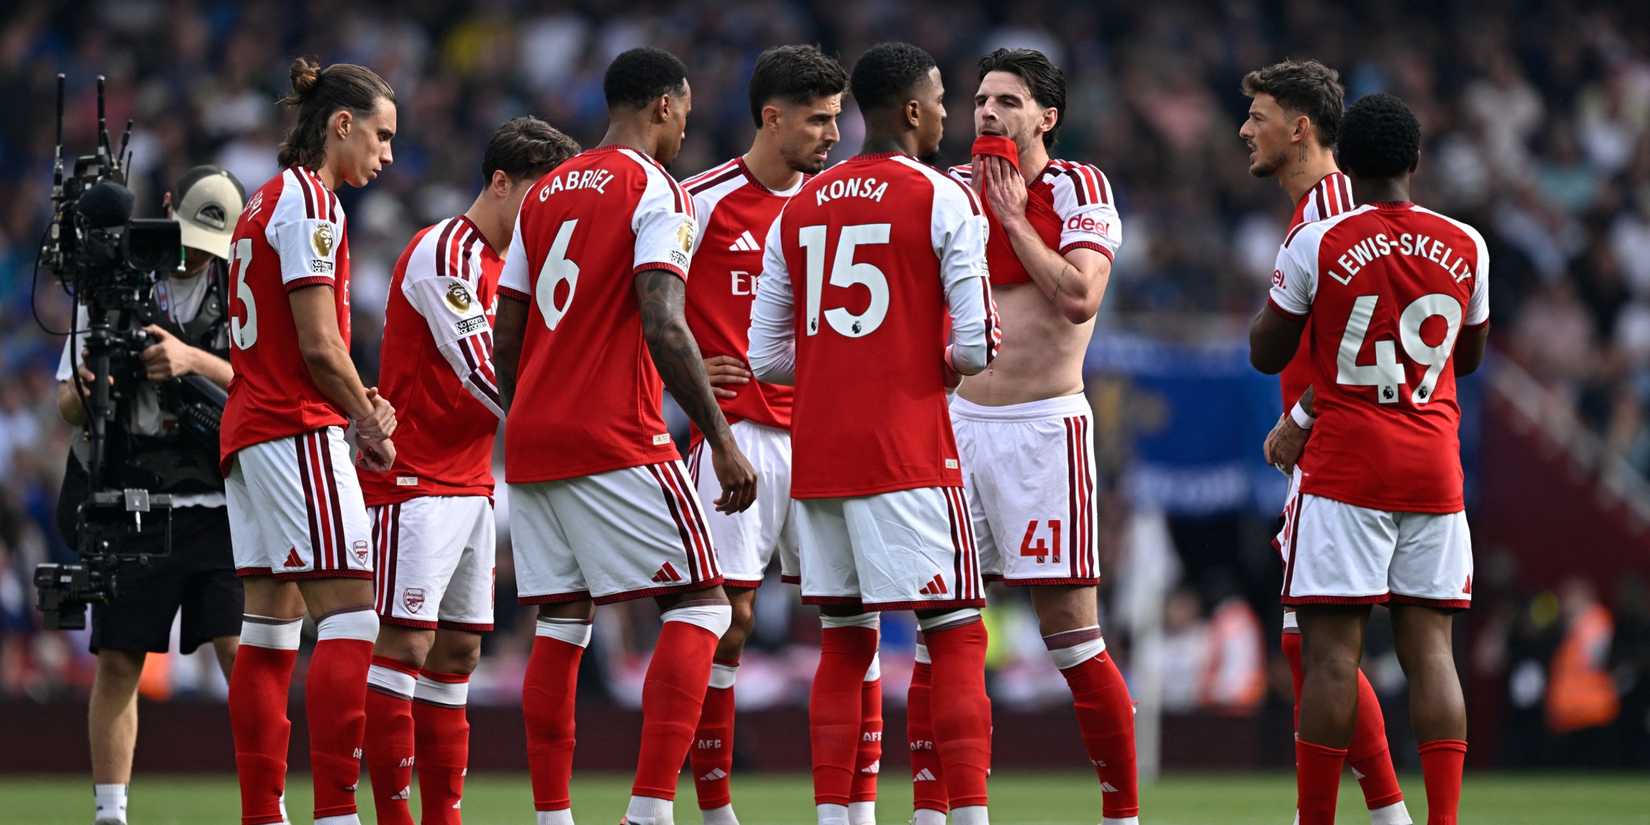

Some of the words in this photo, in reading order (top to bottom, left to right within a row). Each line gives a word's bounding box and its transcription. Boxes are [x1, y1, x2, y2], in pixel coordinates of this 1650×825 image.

[539, 168, 615, 203] GABRIEL
[815, 177, 889, 207] KONSA
[535, 218, 580, 332] 6
[798, 223, 892, 338] 15
[1327, 232, 1472, 287] LEWIS-SKELLY
[1336, 293, 1462, 404] 49
[1020, 519, 1061, 564] 41
